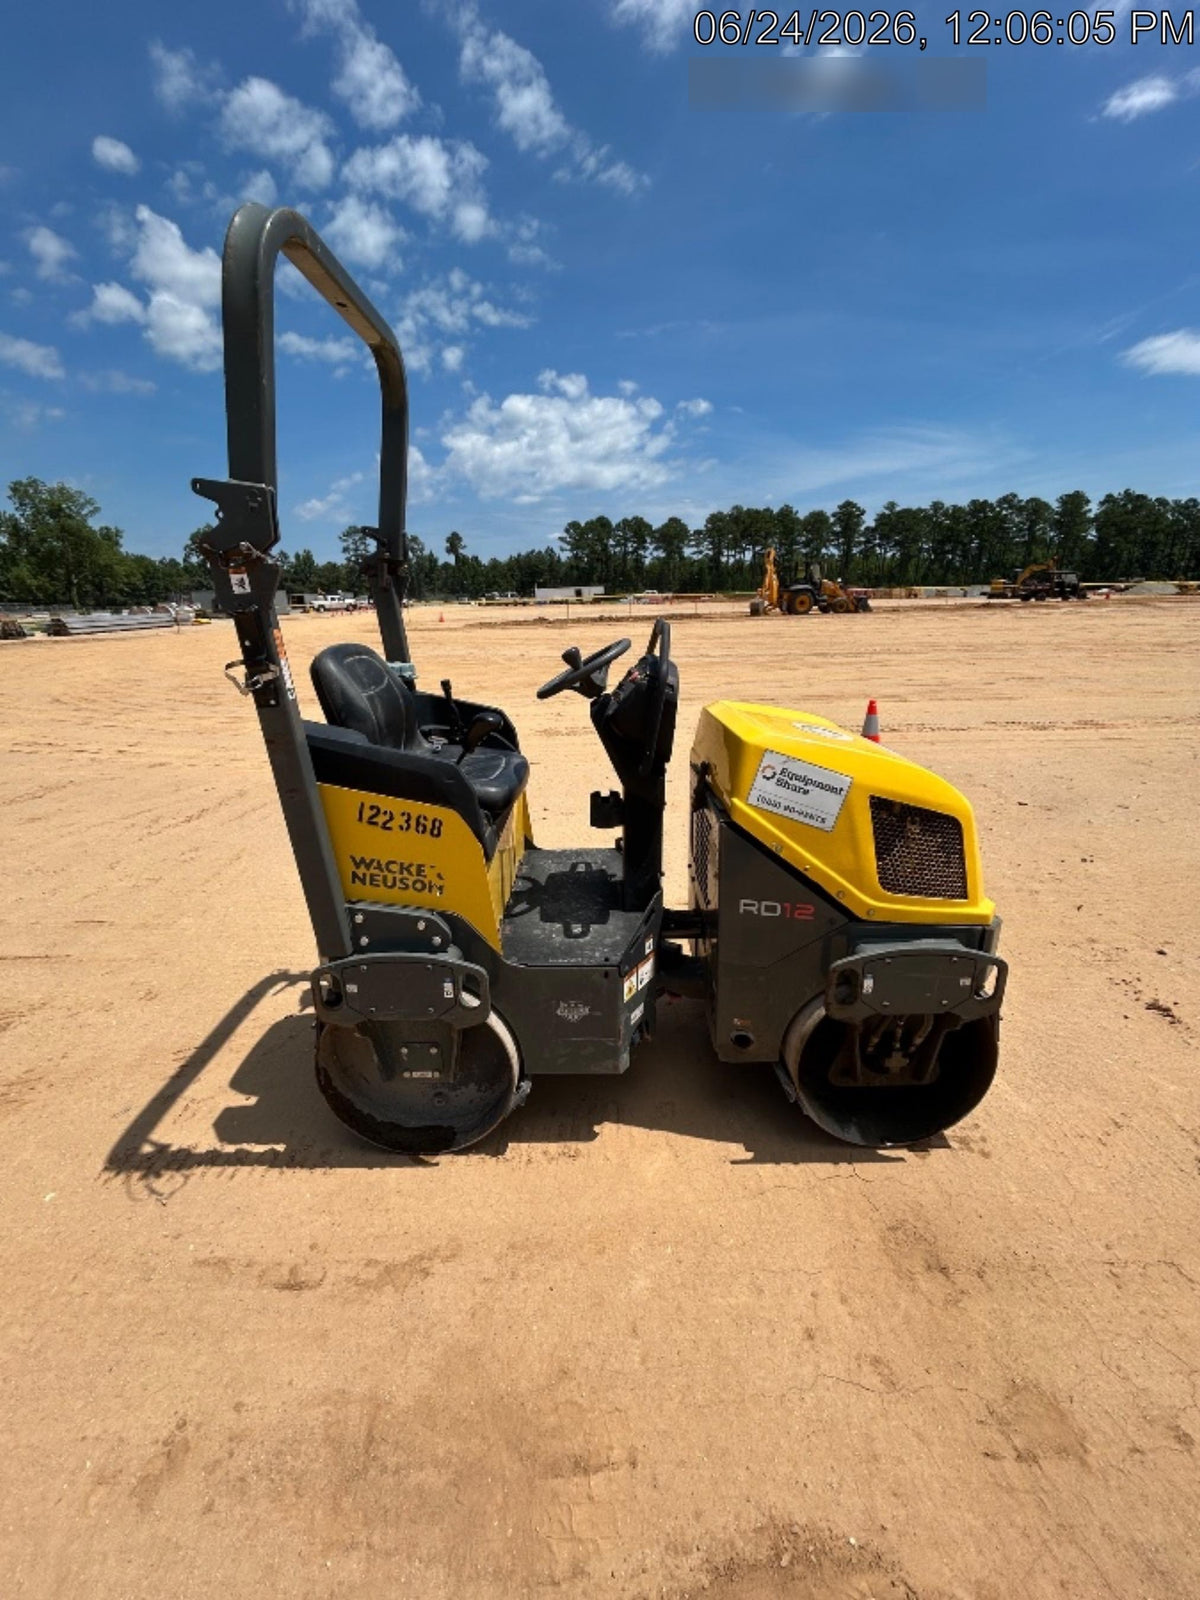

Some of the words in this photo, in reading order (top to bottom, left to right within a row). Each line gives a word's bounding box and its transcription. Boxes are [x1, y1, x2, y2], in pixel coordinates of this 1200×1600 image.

[775, 777, 810, 795] Share
[779, 767, 844, 795] Equipment
[357, 802, 443, 838] 122368
[350, 855, 444, 880] WACKE
[739, 899, 815, 920] RD12
